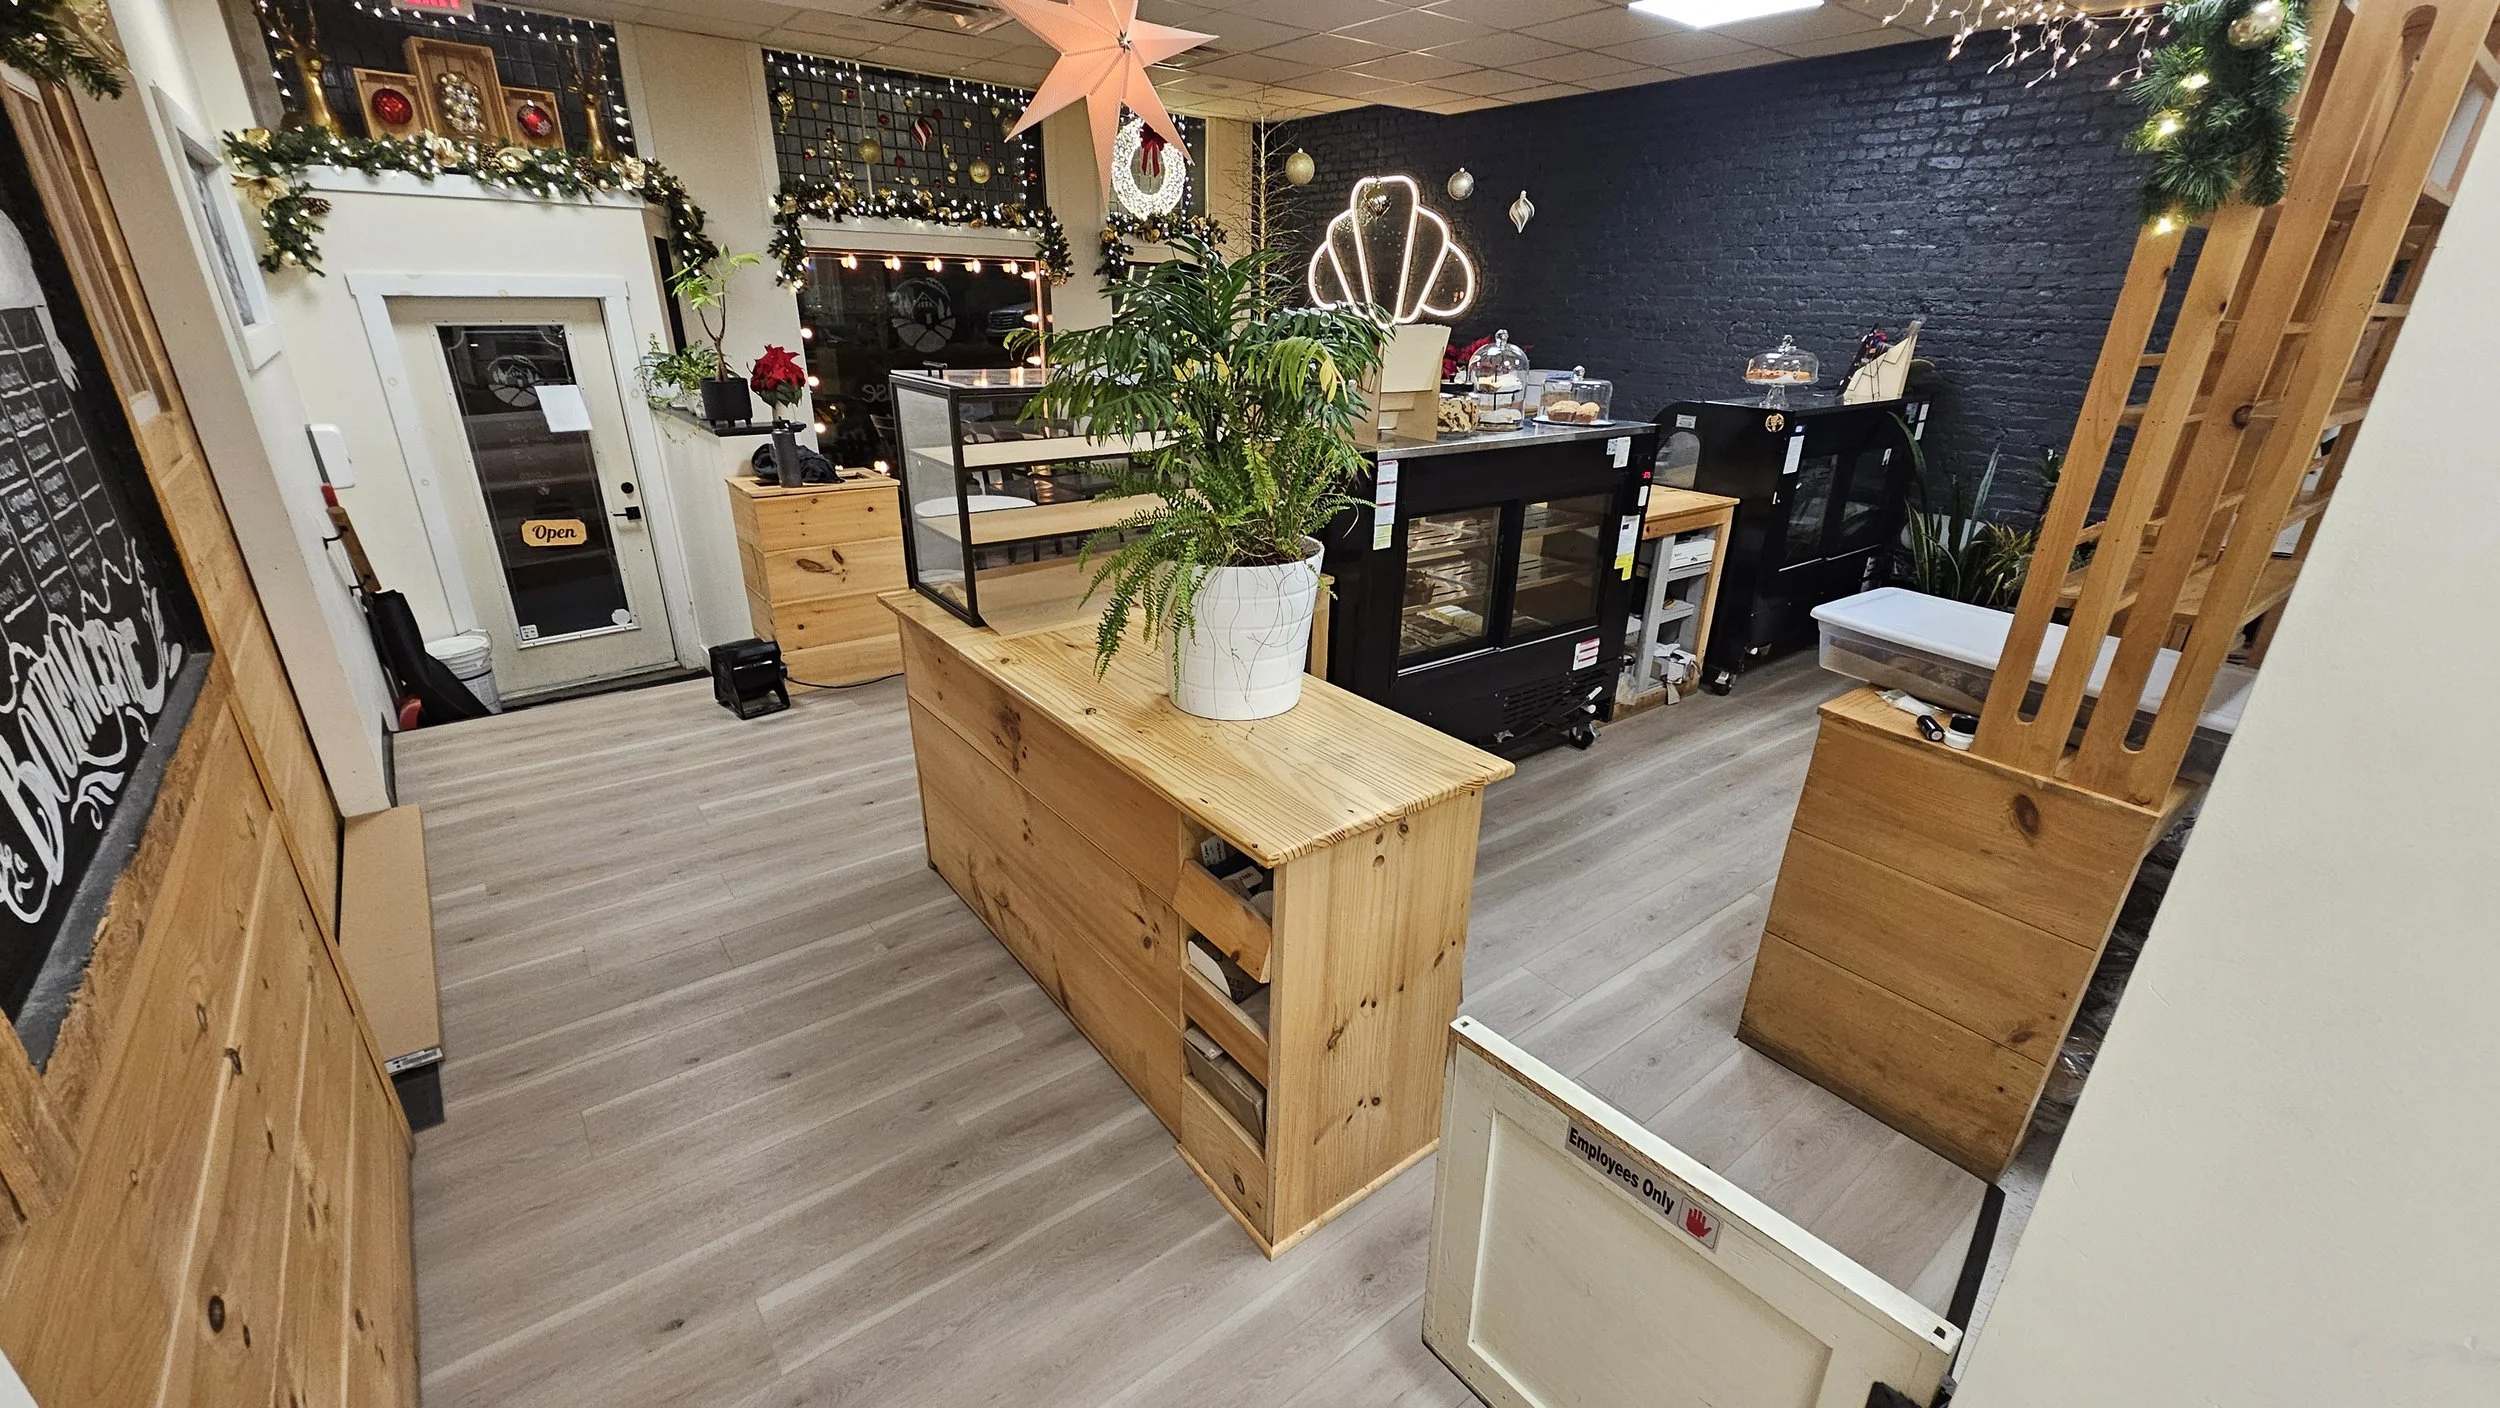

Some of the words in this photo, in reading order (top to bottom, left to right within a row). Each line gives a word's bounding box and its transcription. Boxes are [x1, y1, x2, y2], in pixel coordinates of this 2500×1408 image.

[531, 524, 577, 543] Open
[1568, 1127, 1640, 1189] Employees
[1642, 1178, 1675, 1215] Only
